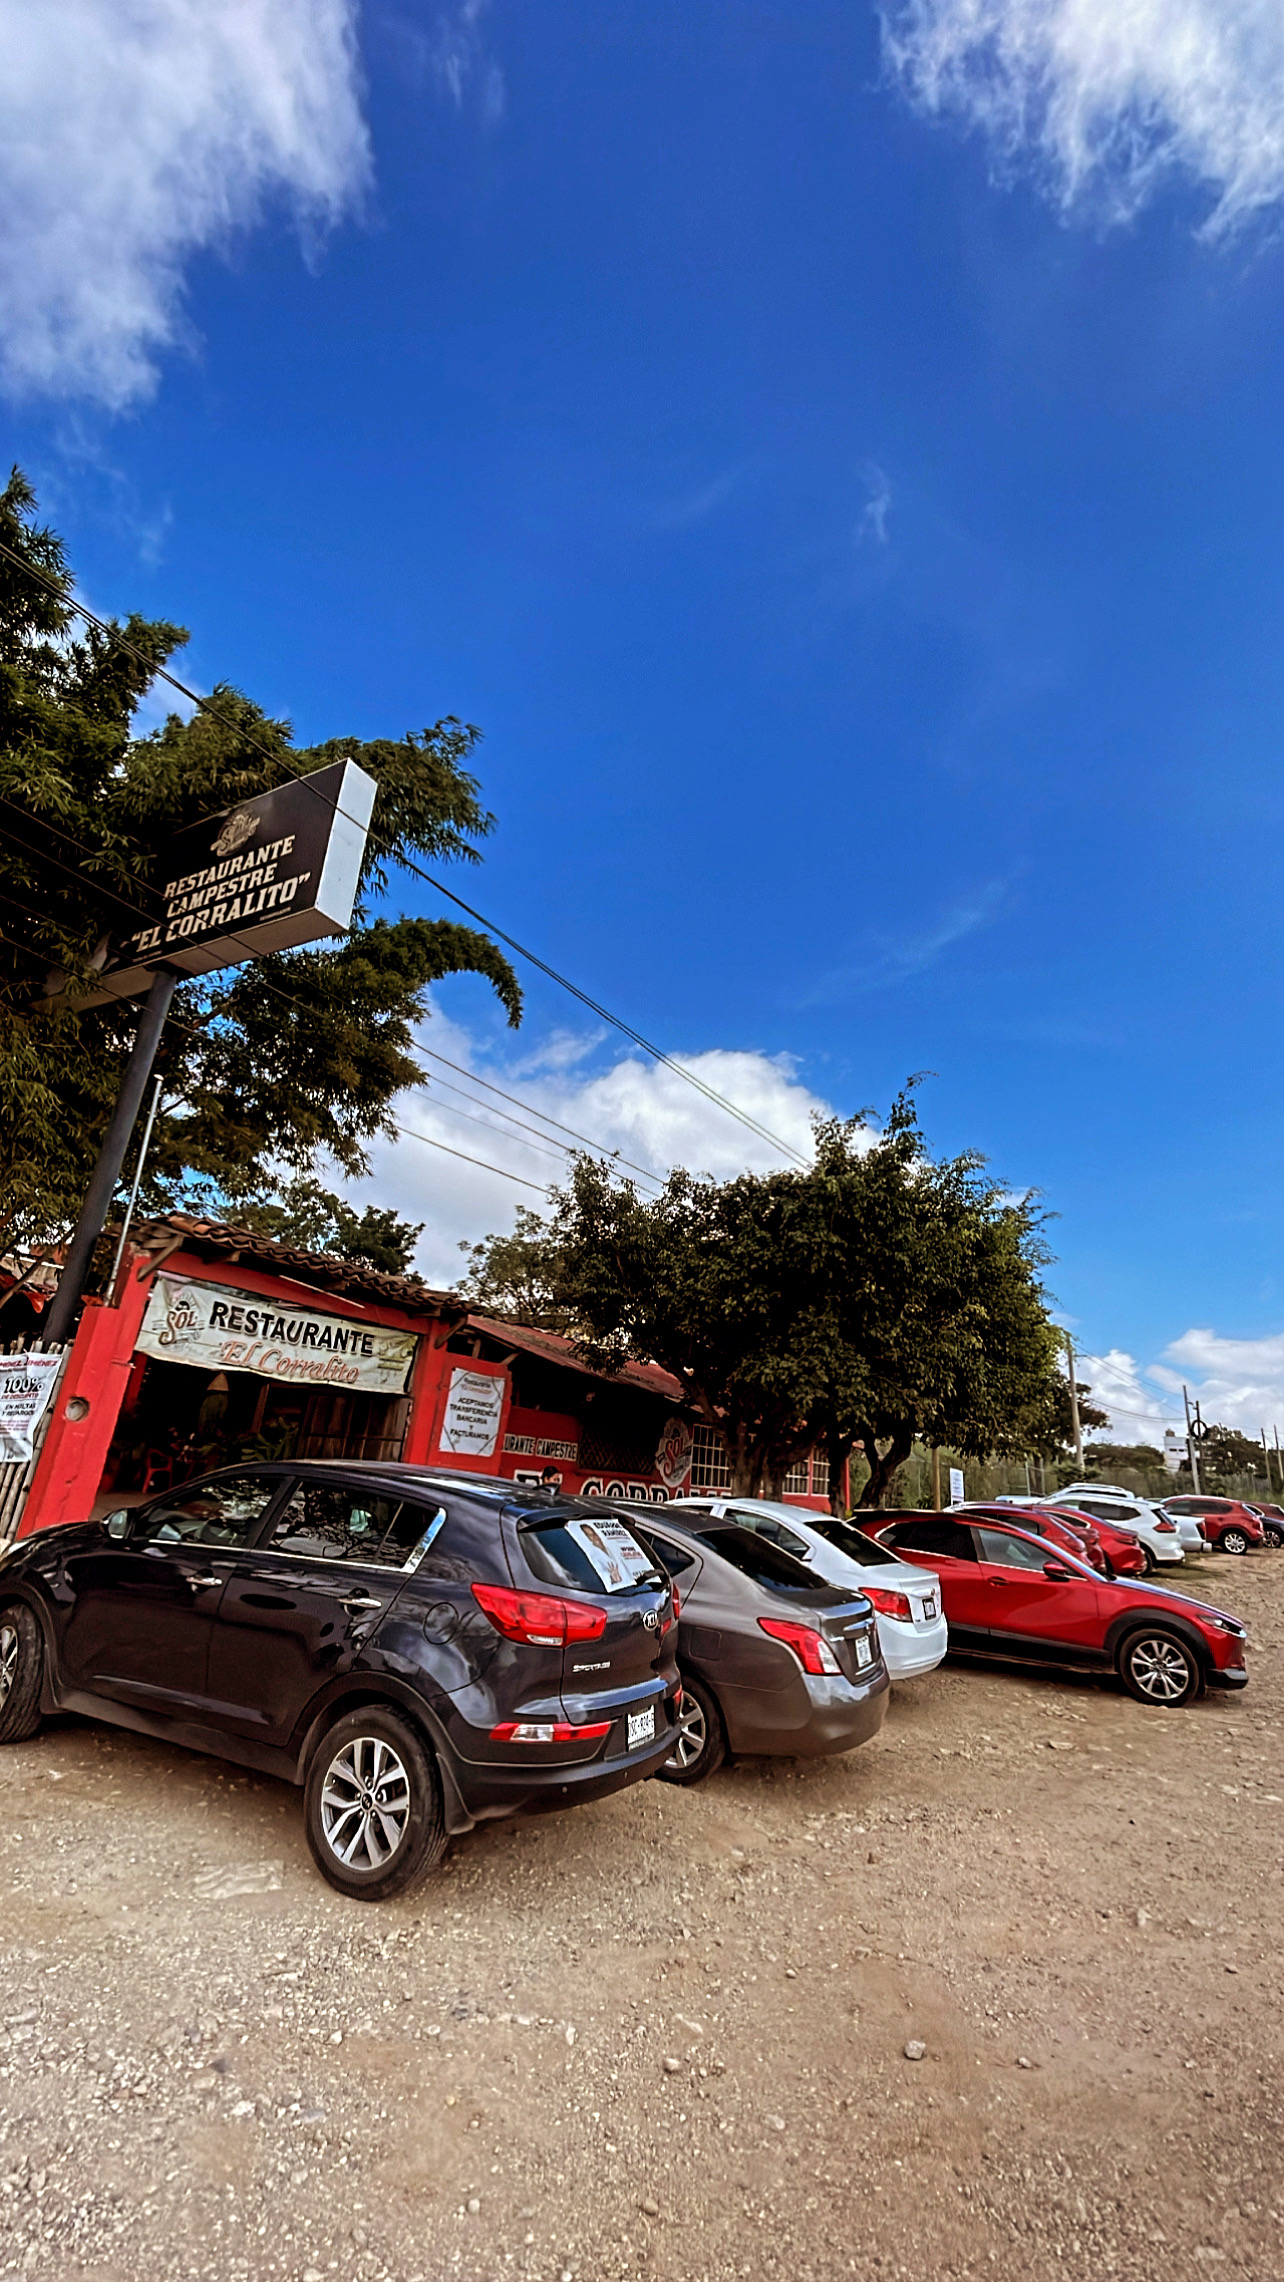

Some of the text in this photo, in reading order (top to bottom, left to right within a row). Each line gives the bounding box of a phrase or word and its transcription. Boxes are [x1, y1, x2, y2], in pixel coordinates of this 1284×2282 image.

[164, 835, 296, 897] RESTAURANTE
[166, 863, 278, 918] CAMPESTRE
[159, 1310, 195, 1345] SOL
[208, 1301, 375, 1356] RESTAURANTE
[220, 1340, 263, 1366] El
[258, 1347, 360, 1383] Corralito
[4, 1375, 45, 1393] 100%
[450, 1404, 497, 1417] TRANSFERENCIA
[458, 1397, 493, 1408] ACEPTAMOS
[456, 1414, 487, 1424] BANCARIA
[450, 1428, 489, 1440] FACTURAMOS
[536, 1438, 578, 1462] CAMPESTRE
[663, 1437, 686, 1477] SOL
